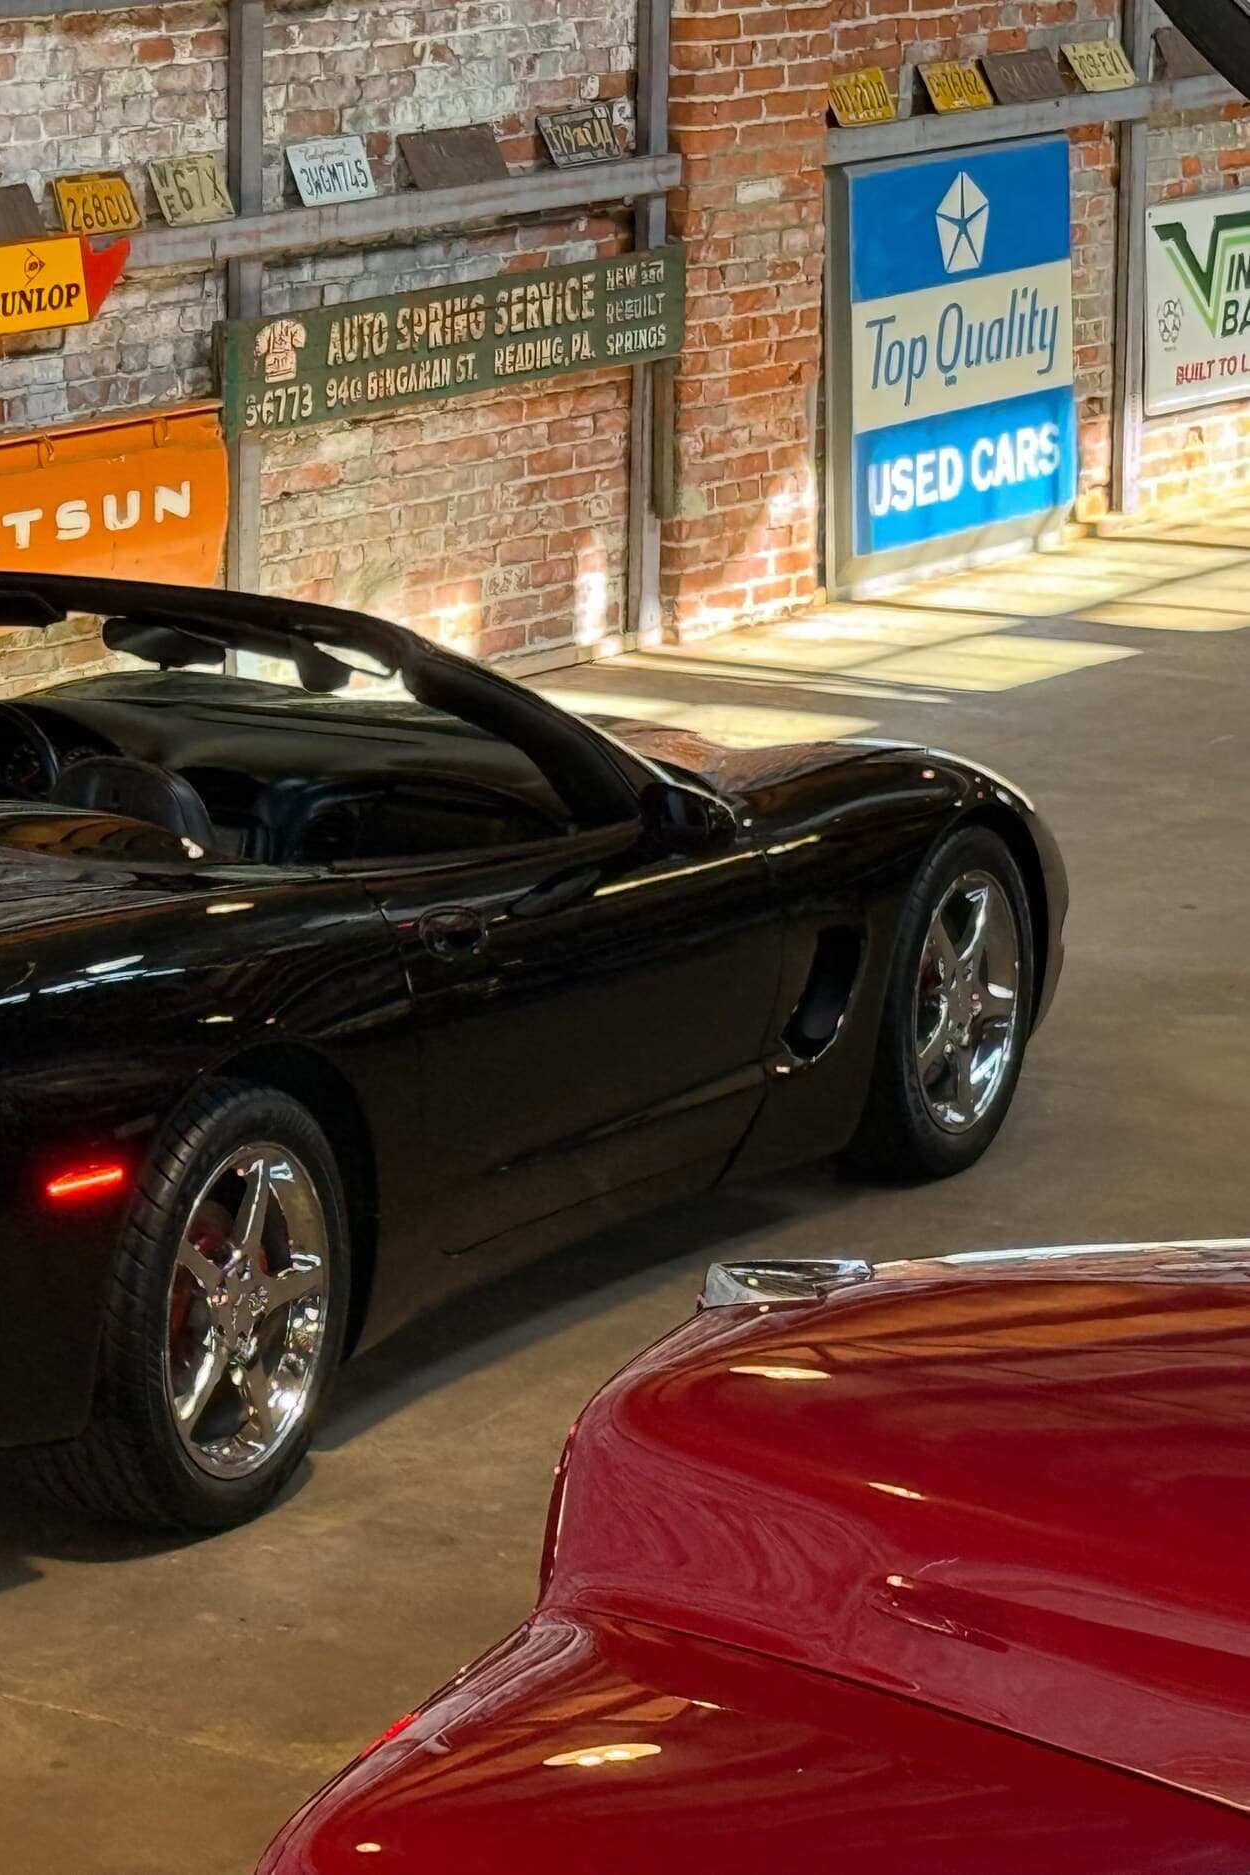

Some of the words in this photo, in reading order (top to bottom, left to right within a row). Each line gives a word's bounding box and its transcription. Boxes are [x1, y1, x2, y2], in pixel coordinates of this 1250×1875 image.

[173, 166, 227, 212] 67X
[67, 194, 132, 232] 268CU
[605, 264, 638, 291] NEW
[327, 311, 389, 366] AUTO
[396, 294, 486, 353] SPRING
[494, 272, 596, 336] SERVICE
[606, 293, 666, 324] REBUILT
[606, 323, 667, 356] SPRINGS
[865, 315, 926, 406] Top
[936, 287, 1059, 386] Quality
[367, 357, 450, 401] BINGAMAN
[456, 353, 478, 384] ST.
[1176, 358, 1215, 385] BUILT
[1218, 356, 1237, 377] TO
[868, 447, 964, 516] USED
[971, 422, 1061, 492] CARS
